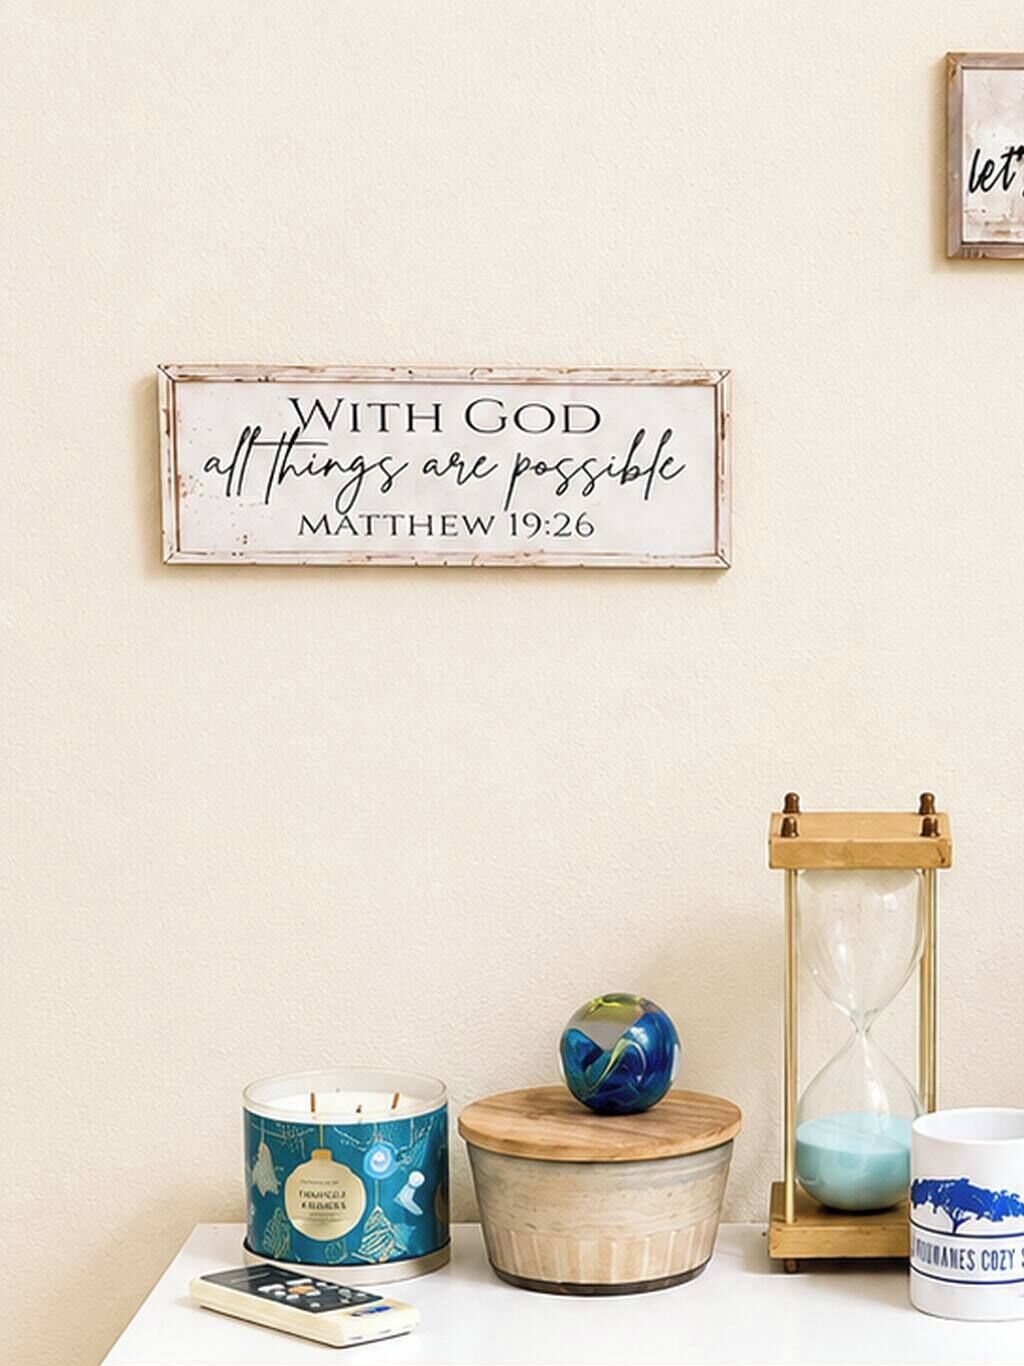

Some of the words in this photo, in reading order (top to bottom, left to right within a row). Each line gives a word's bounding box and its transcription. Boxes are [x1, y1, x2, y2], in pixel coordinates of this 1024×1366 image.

[203, 425, 262, 497] all
[252, 425, 411, 515] things
[422, 450, 499, 483] are
[504, 428, 687, 512] possible
[297, 512, 497, 538] MATTHEW
[509, 512, 596, 539] 19:26
[980, 1247, 1016, 1272] COZY
